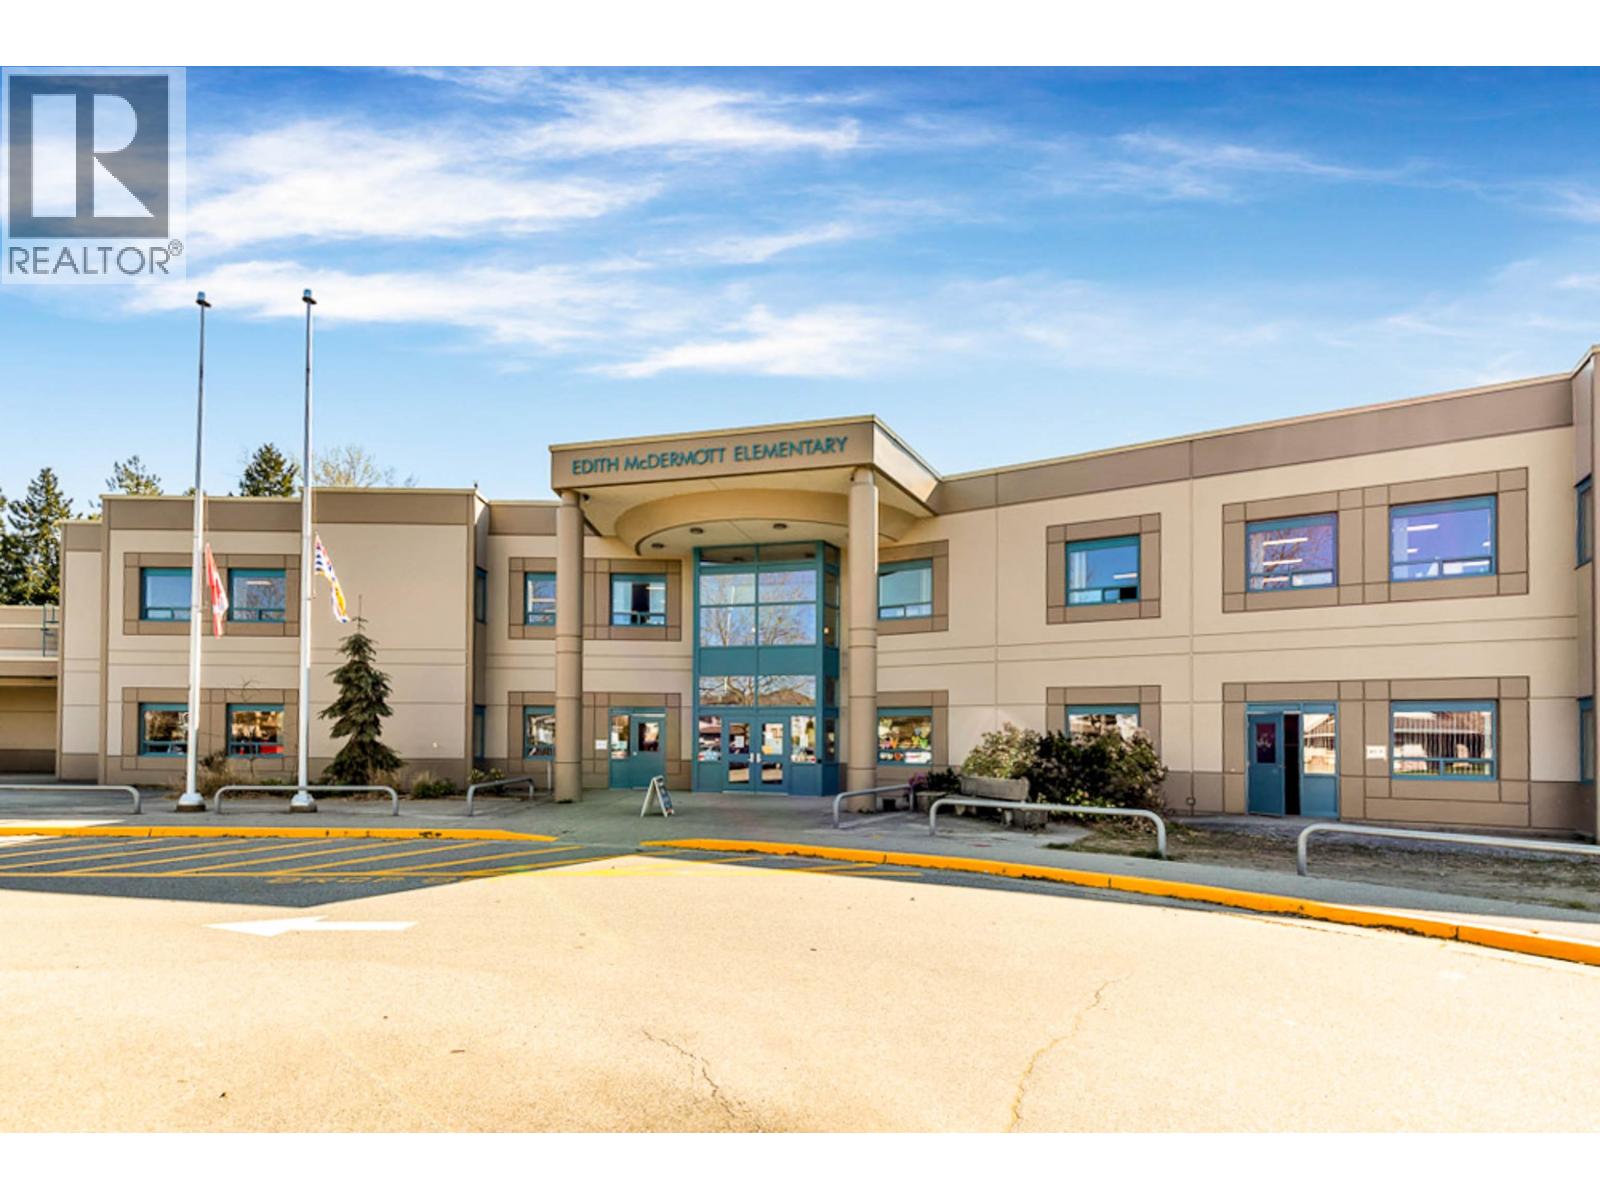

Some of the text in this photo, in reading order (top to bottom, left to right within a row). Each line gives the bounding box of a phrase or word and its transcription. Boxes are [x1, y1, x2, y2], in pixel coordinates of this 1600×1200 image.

[572, 436, 847, 475] EDITH McDERMOTT ELEMENTARY
